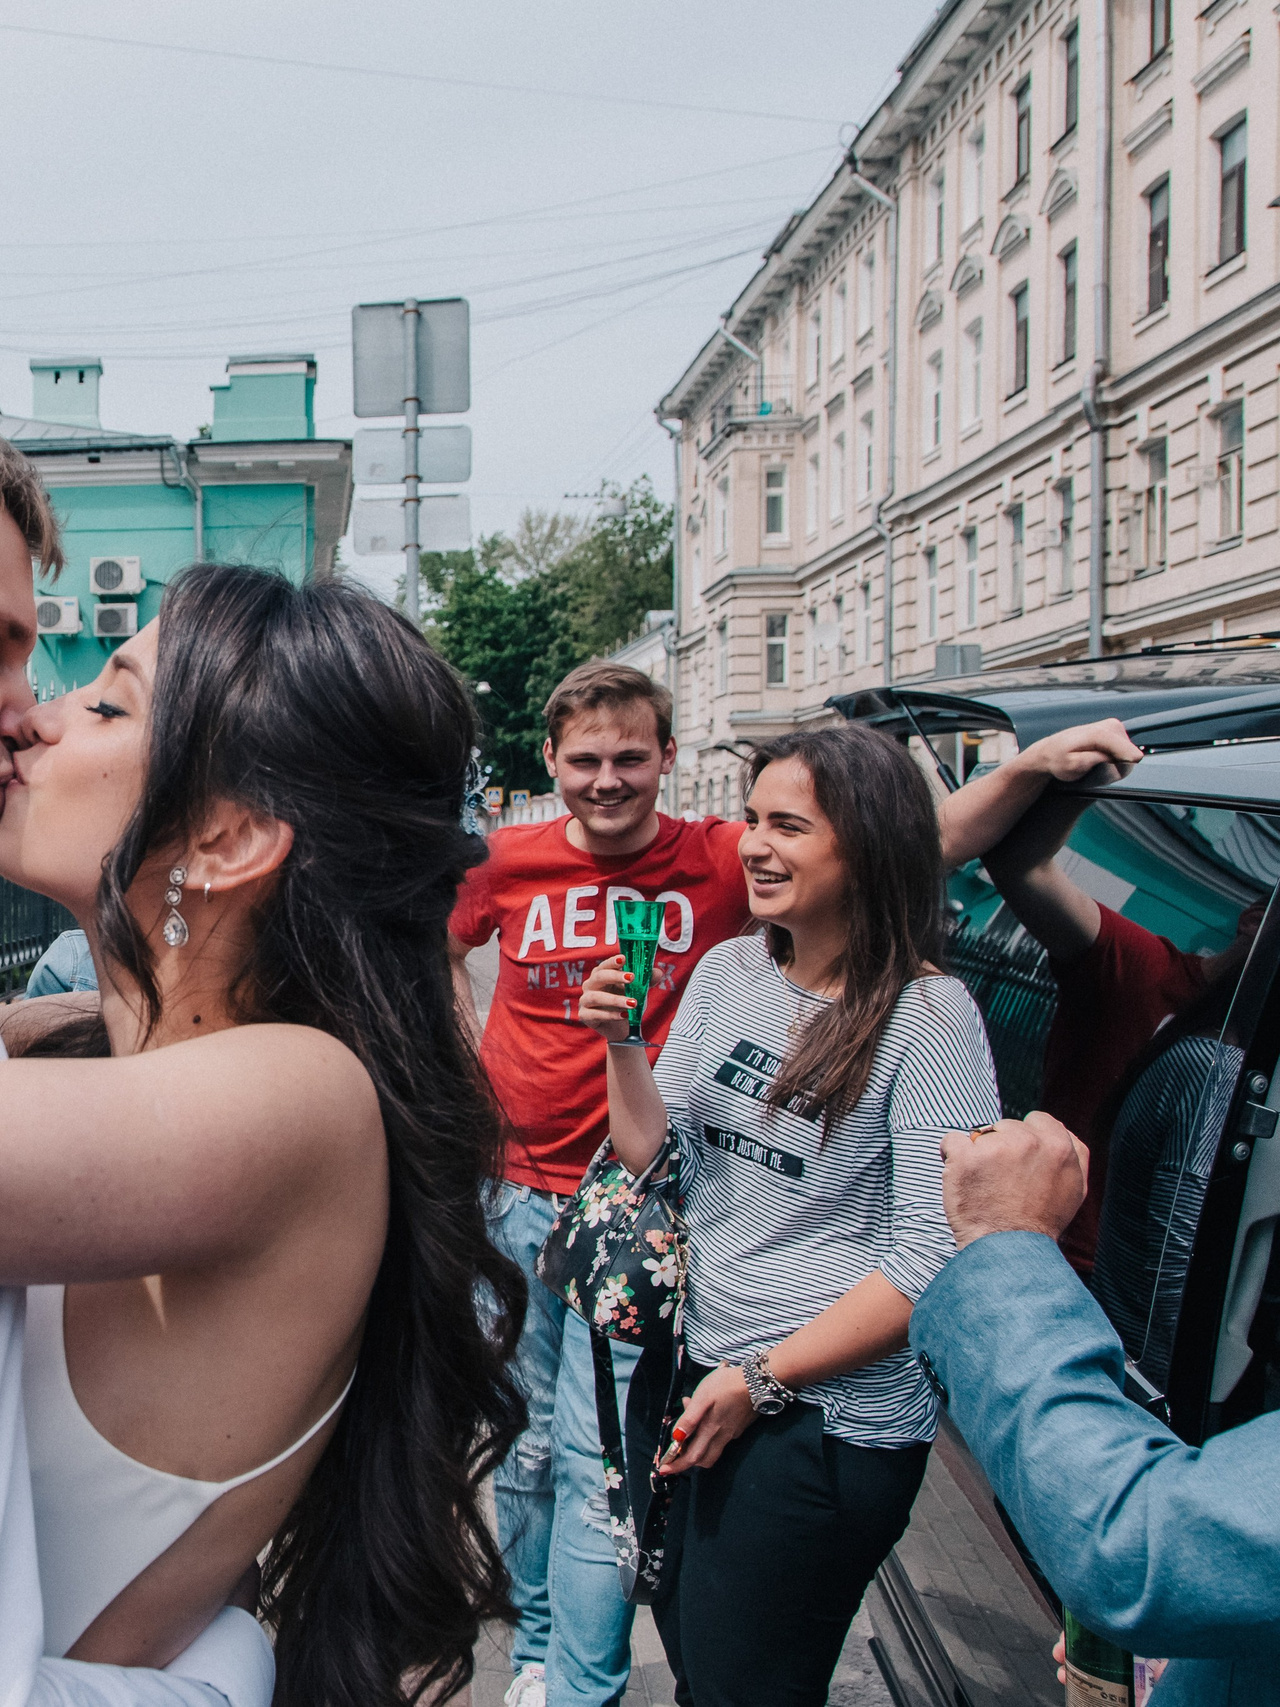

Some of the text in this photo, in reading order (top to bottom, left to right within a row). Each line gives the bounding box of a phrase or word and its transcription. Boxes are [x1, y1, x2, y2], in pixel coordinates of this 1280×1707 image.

[517, 886, 694, 960] AERO
[527, 960, 586, 991] NEW
[745, 1048, 765, 1067] I'M
[730, 1071, 760, 1096] BEING
[718, 1132, 736, 1151] IT'S
